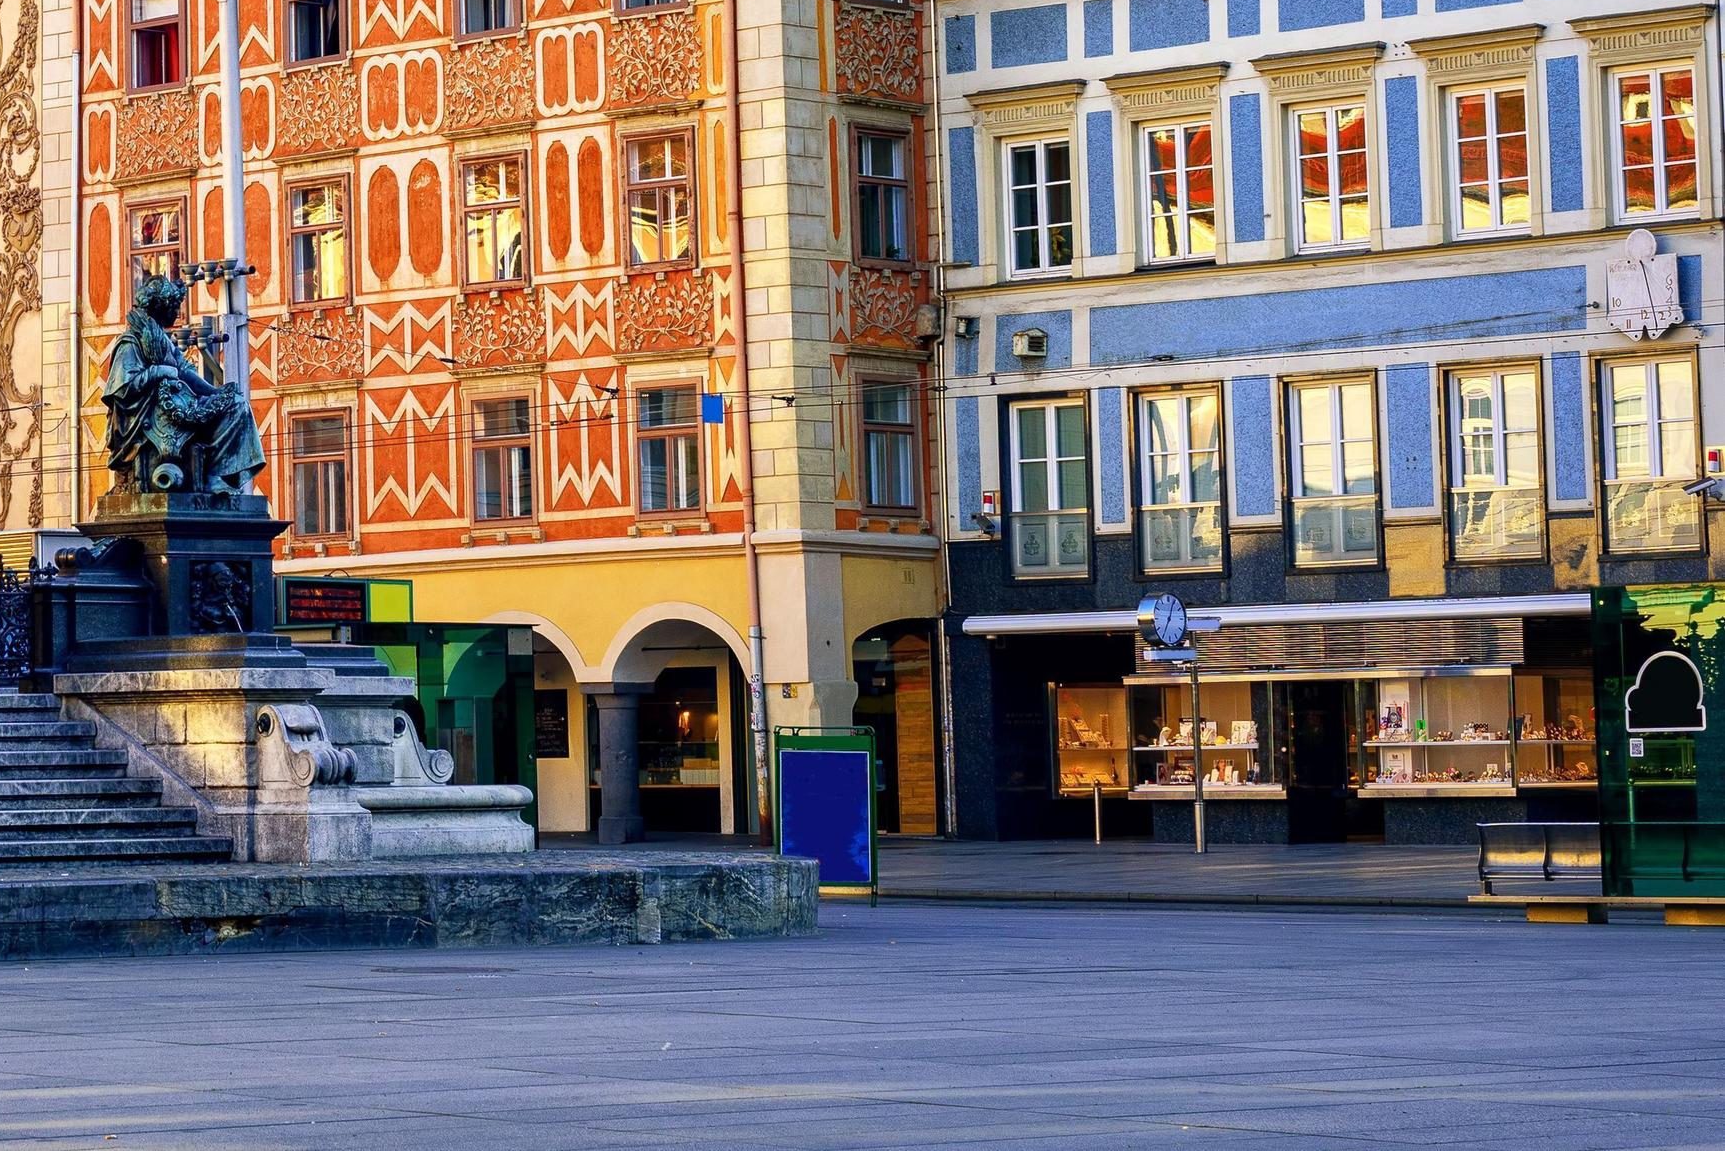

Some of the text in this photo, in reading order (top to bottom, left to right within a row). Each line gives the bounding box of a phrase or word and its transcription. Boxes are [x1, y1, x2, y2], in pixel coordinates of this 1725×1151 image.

[1611, 296, 1622, 307] 10
[1640, 309, 1651, 320] 12
[1658, 311, 1666, 321] 2
[1626, 319, 1632, 329] 11
